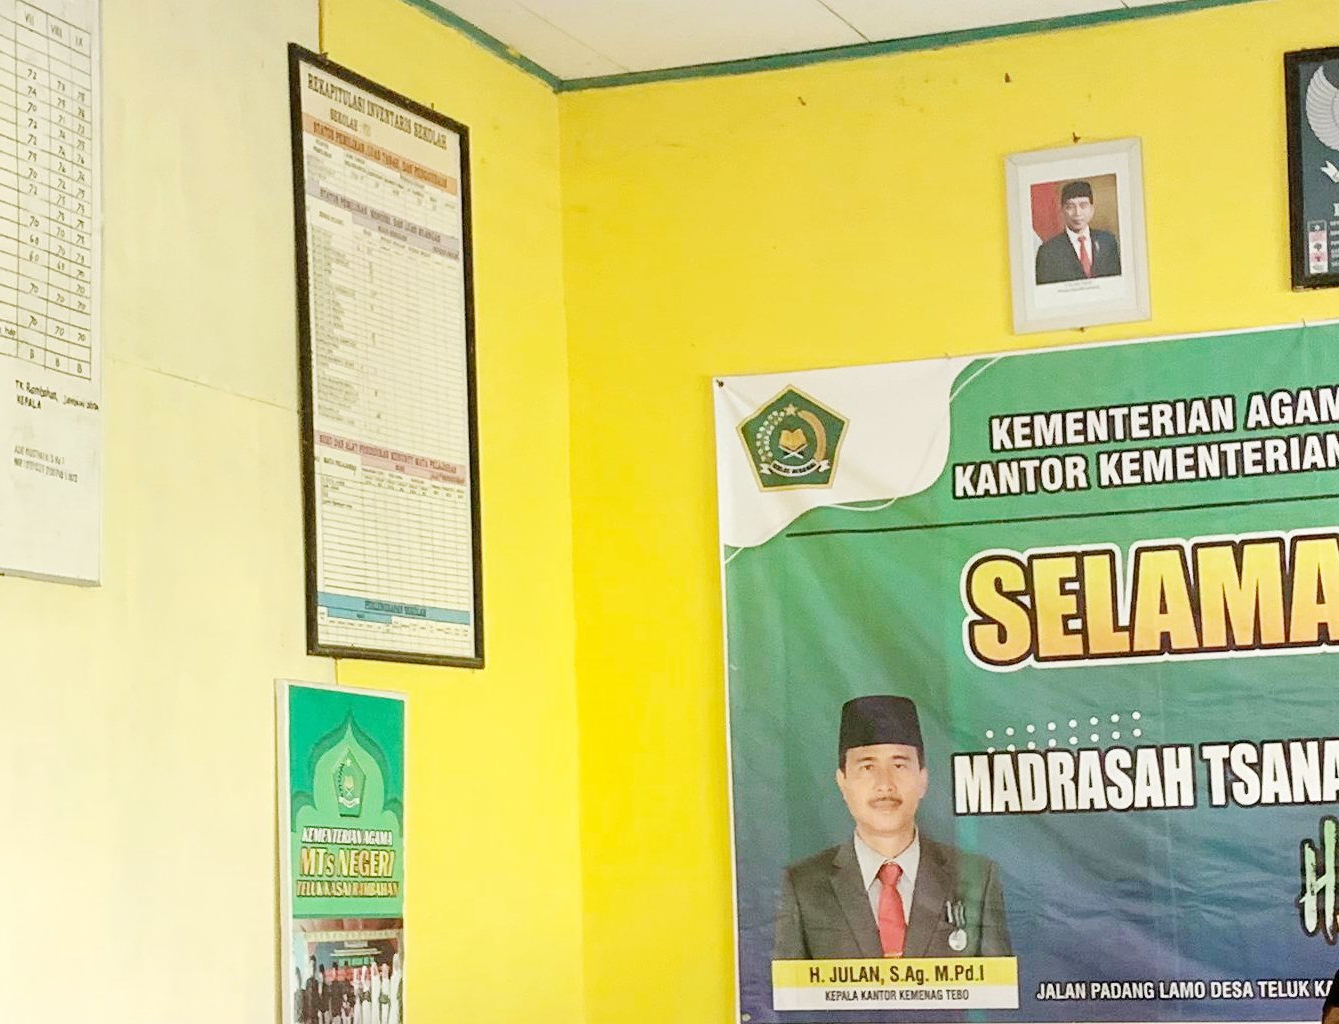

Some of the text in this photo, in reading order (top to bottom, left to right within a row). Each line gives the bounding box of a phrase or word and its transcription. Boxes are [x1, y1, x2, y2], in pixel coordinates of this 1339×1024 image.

[307, 72, 366, 113] REKAPITULASI
[990, 396, 1235, 453] KEMENTERIAN
[953, 455, 1090, 499] KANTOR
[953, 745, 1194, 816] MADRASAH
[300, 846, 396, 879] MTs NEGERI
[809, 966, 826, 984] H.
[829, 966, 886, 986] JULAN,
[889, 965, 930, 986] S.Ag.
[1036, 982, 1087, 1000] JALAN
[1090, 981, 1155, 1000] PADANG
[1158, 981, 1205, 999] LAMO
[1209, 980, 1255, 999] DESA
[1257, 980, 1311, 999] TELUK
[824, 988, 970, 1002] KEPALA KANTOR KEMENAG TEBO
